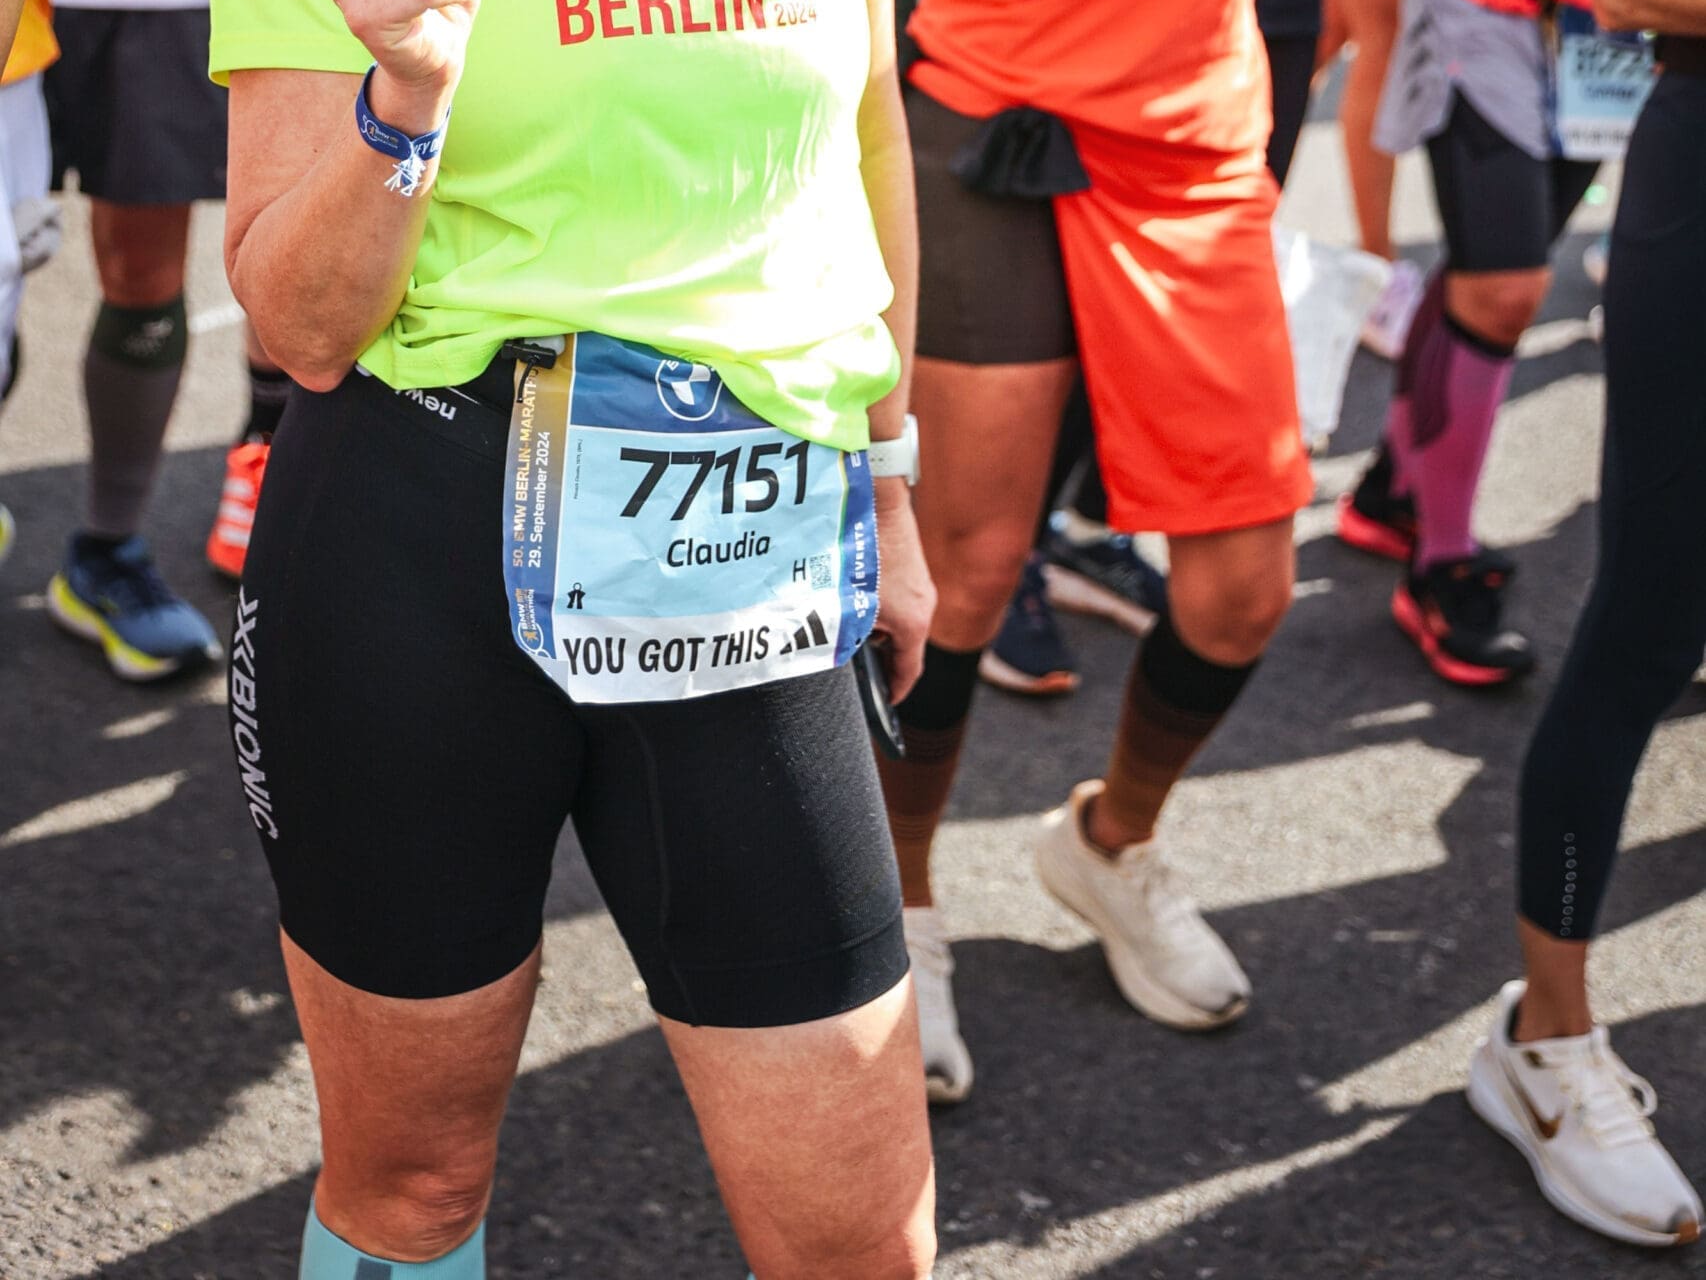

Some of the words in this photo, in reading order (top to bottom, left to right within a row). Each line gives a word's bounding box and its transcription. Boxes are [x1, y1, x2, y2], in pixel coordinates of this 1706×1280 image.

[773, 2, 818, 28] 2024
[535, 431, 551, 466] 2024
[619, 440, 811, 522] 77151
[513, 503, 528, 542] BMW
[530, 467, 548, 544] September
[512, 545, 525, 568] 50.
[528, 545, 543, 569] 29.
[666, 530, 771, 568] Claudia
[853, 521, 867, 580] EVENTS
[792, 557, 807, 583] H
[562, 636, 627, 676] YOU
[637, 637, 706, 674] GOT
[710, 624, 771, 668] THIS
